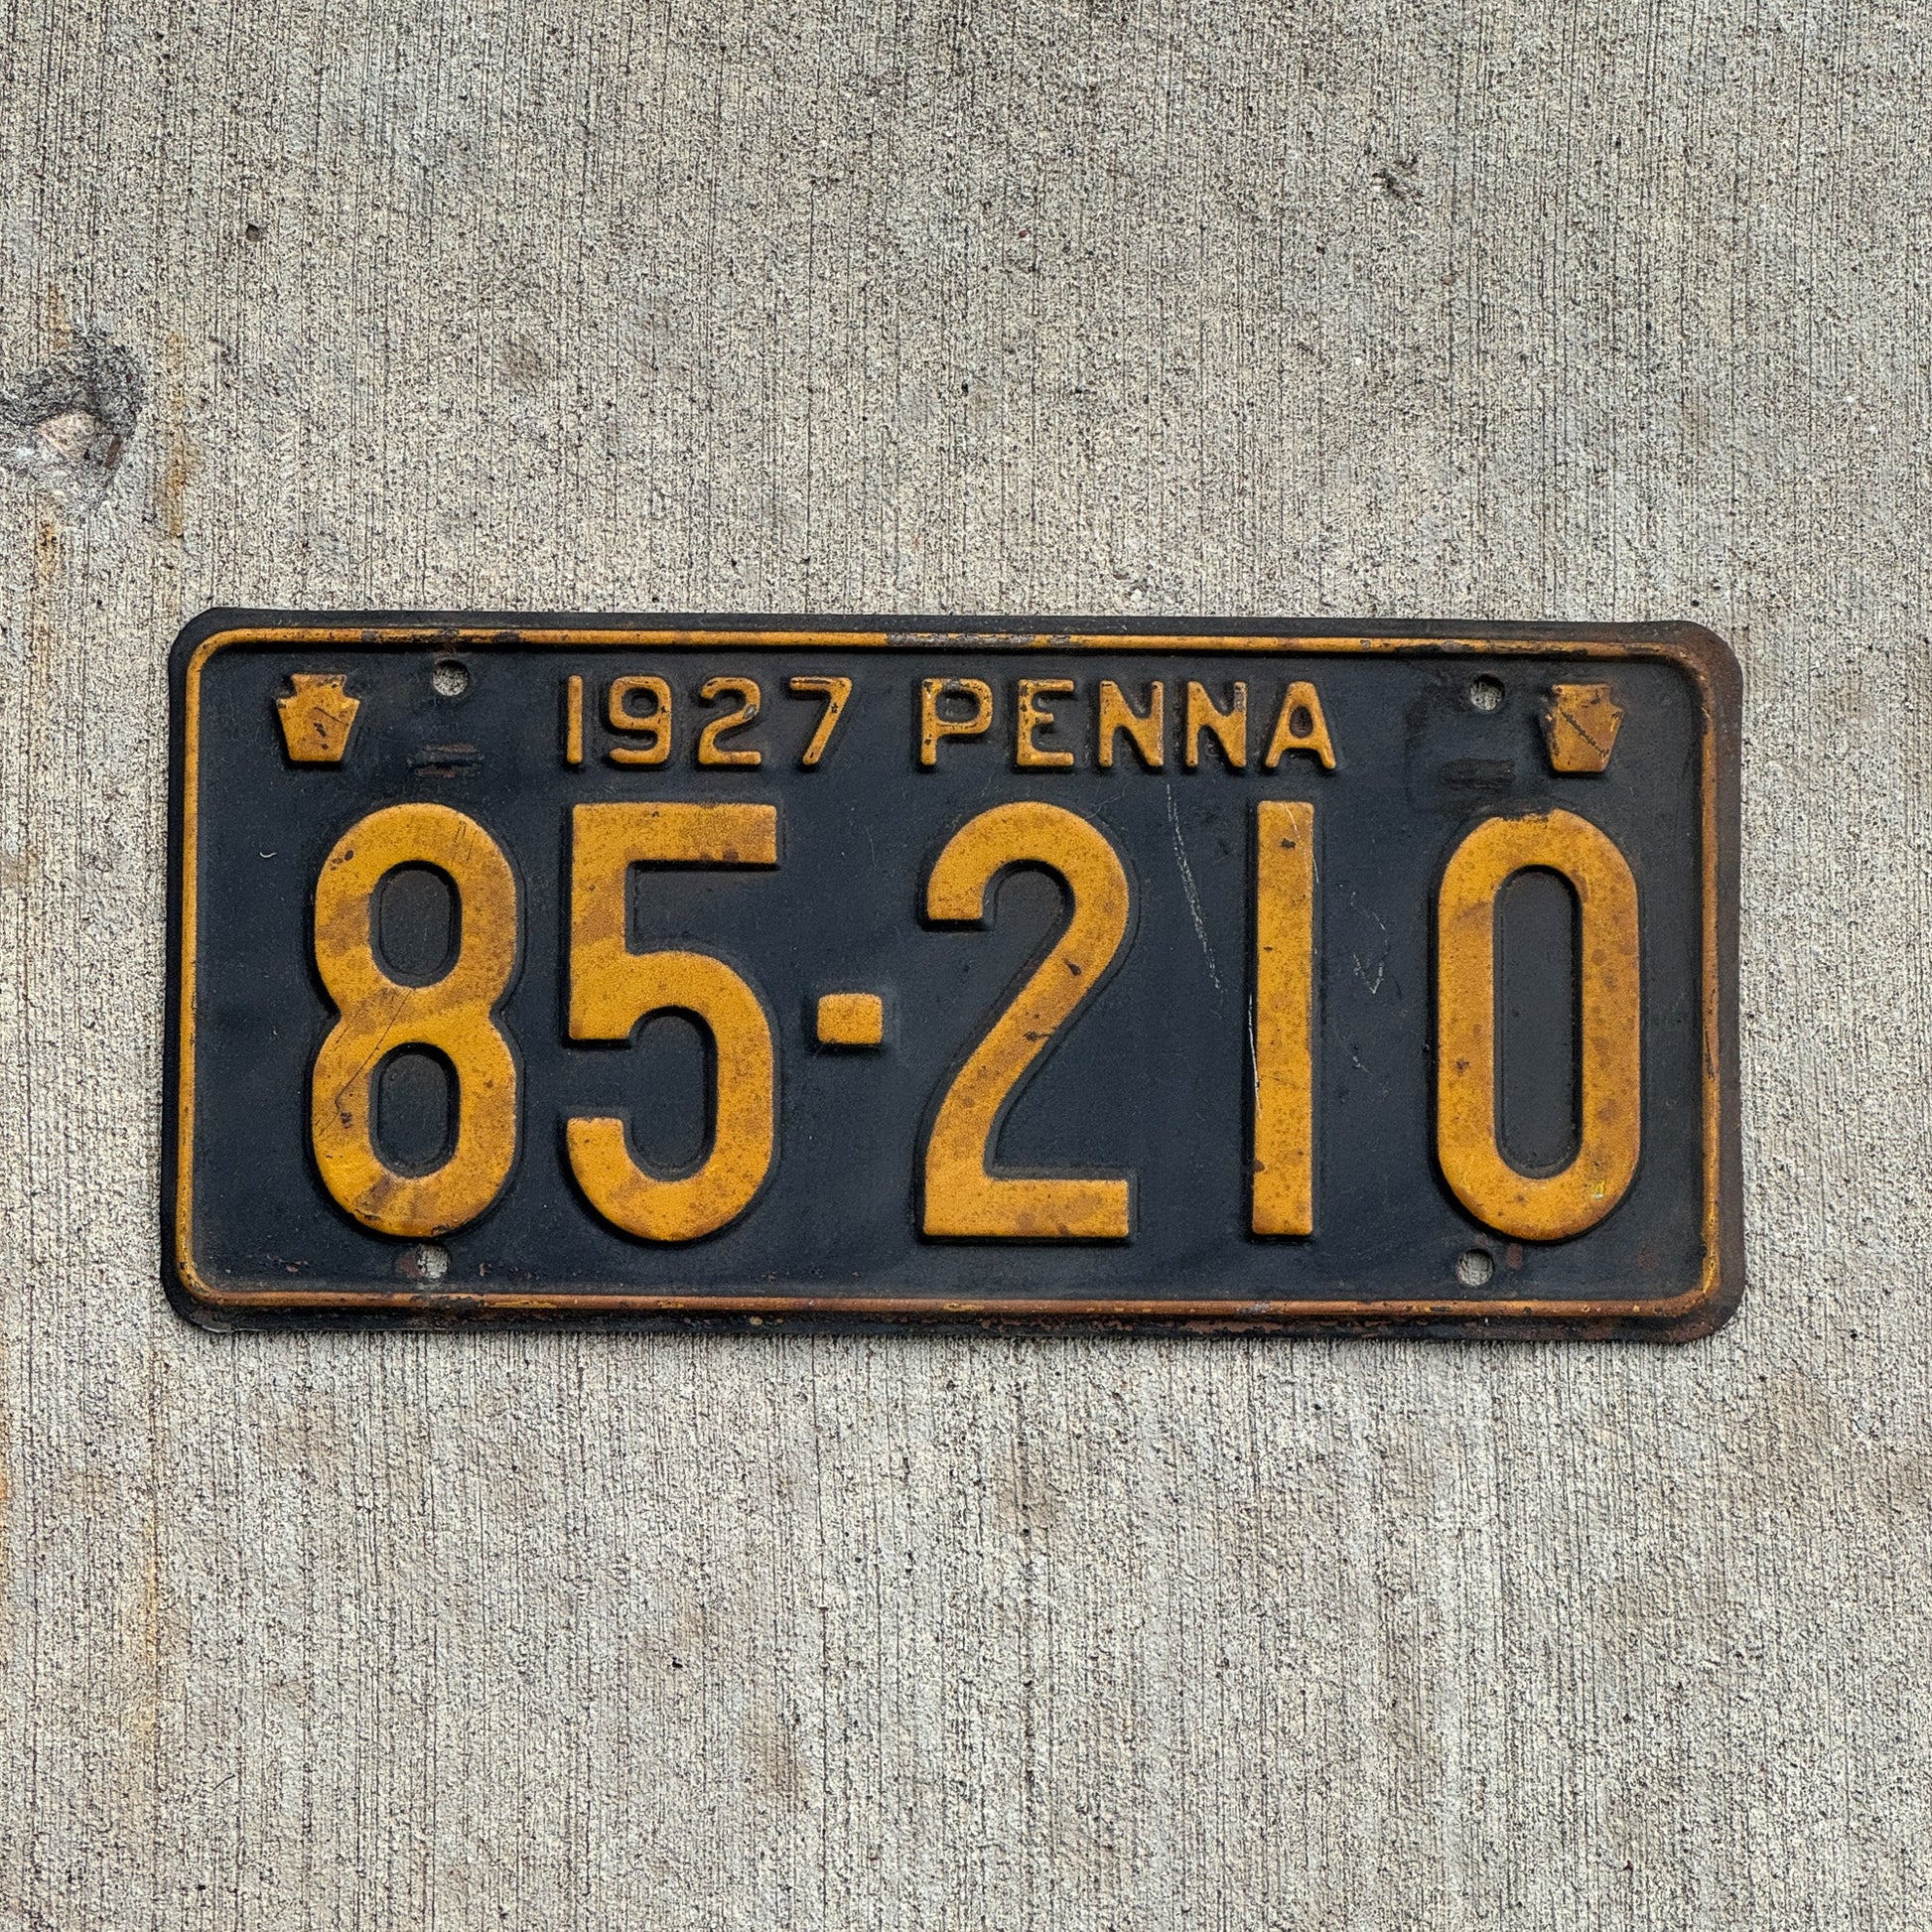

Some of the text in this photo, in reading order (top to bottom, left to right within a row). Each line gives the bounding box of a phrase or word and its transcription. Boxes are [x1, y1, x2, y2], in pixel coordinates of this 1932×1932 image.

[565, 674, 1337, 769] 1927 PENNA
[310, 800, 1642, 1242] 85-210
